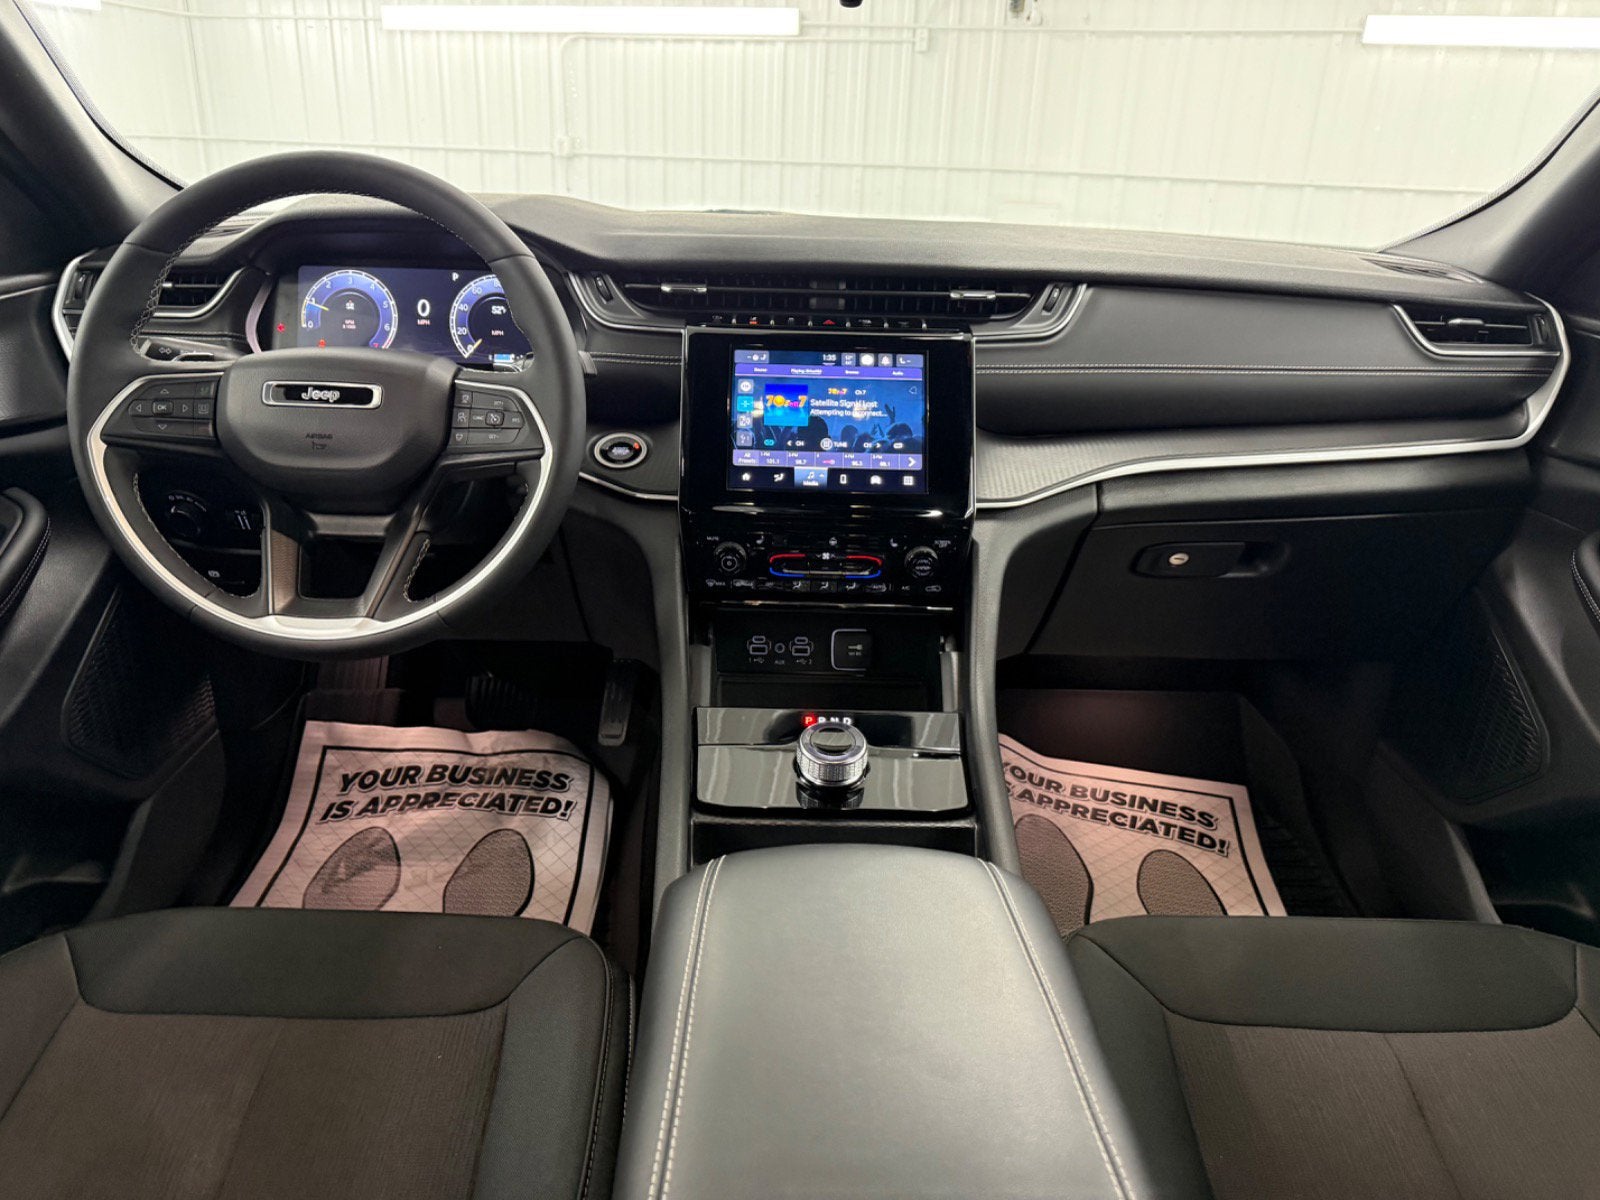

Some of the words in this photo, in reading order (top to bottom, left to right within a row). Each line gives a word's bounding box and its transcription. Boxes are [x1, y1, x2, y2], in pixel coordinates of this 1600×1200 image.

[452, 272, 459, 281] P
[472, 287, 482, 295] 60
[417, 299, 430, 317] 0
[457, 327, 467, 335] 20
[301, 387, 340, 403] Jeep
[810, 399, 839, 407] Satellite
[810, 409, 844, 417] Attempting
[339, 765, 423, 793] YOUR
[425, 764, 574, 791] BUSINESS
[318, 800, 355, 822] IS
[355, 791, 577, 819] APPRECIATED!
[1069, 784, 1219, 829] BUSINESS
[1017, 788, 1230, 855] APPRECIATED!
